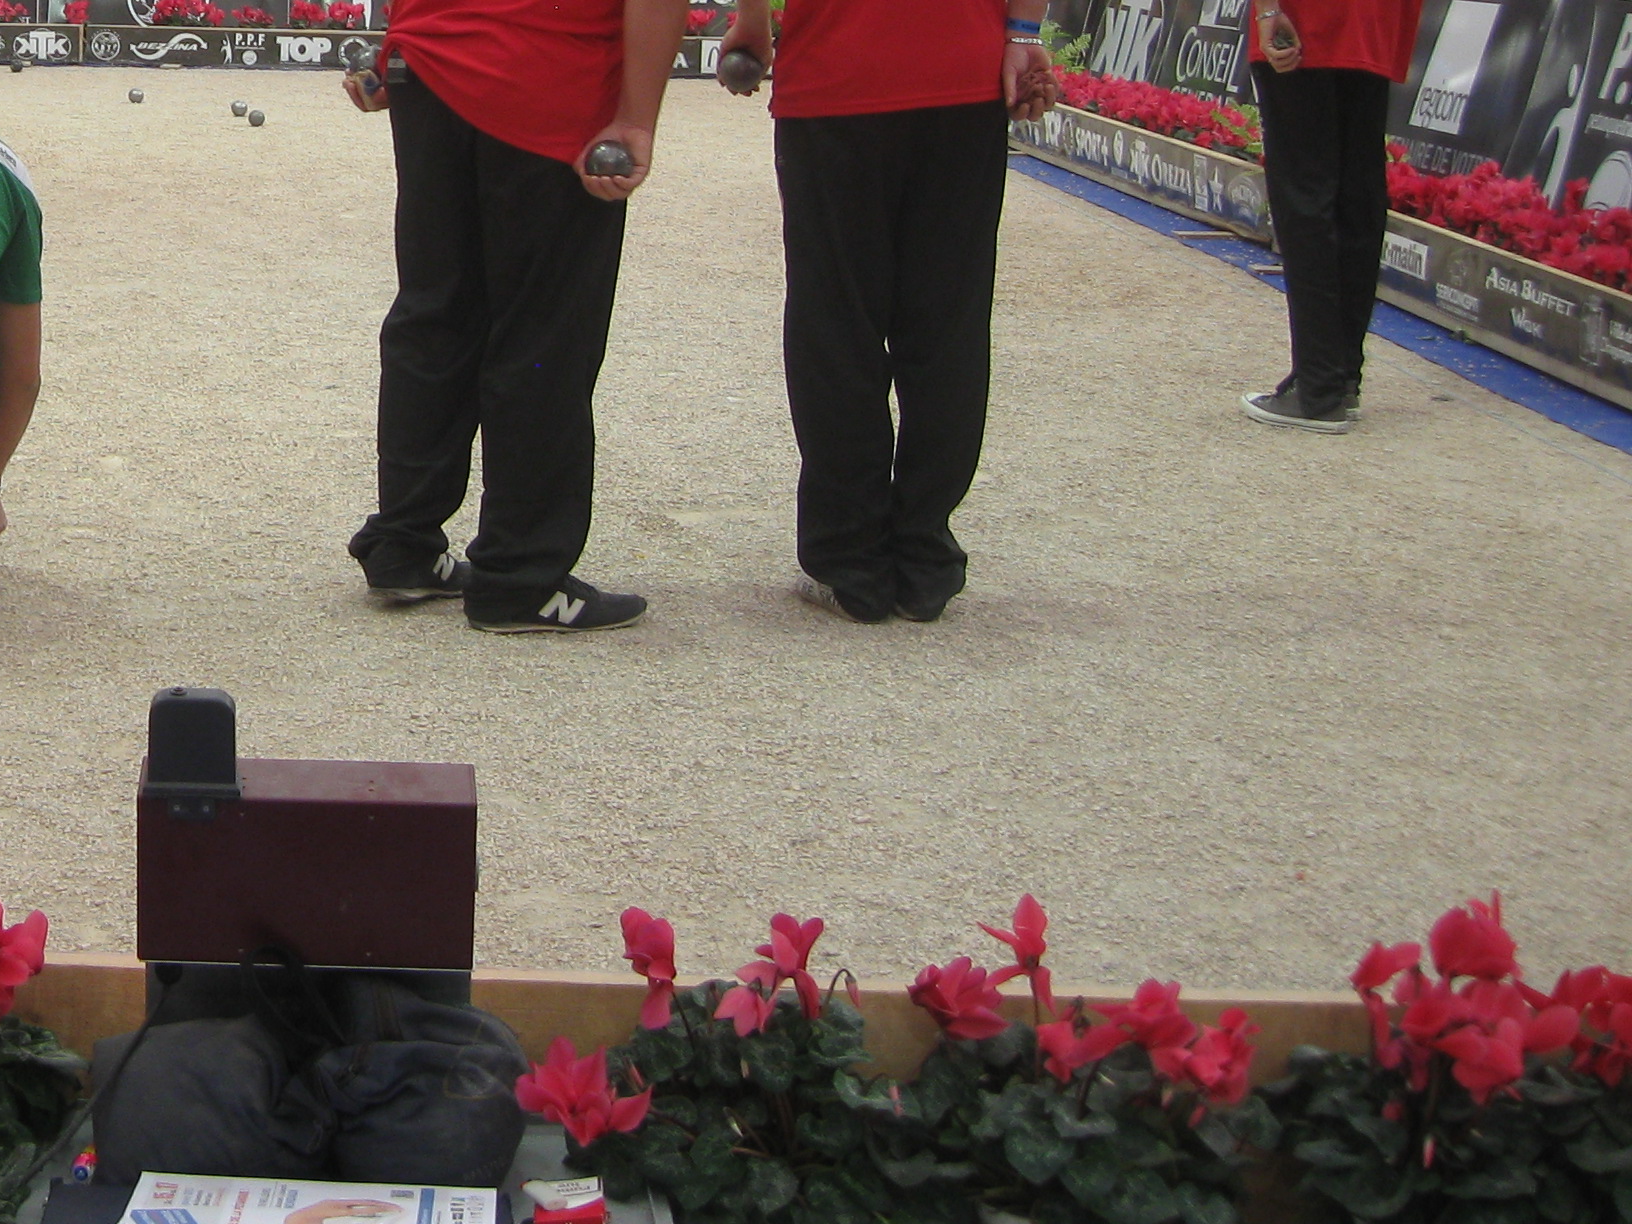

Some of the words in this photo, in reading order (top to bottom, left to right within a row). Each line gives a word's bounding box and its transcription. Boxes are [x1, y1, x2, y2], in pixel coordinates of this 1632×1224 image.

[16, 30, 68, 60] KTK
[276, 35, 332, 63] TOP
[1176, 26, 1245, 93] CONSEIL
[1485, 266, 1519, 297] ASIA
[1520, 279, 1577, 317] BUFFET
